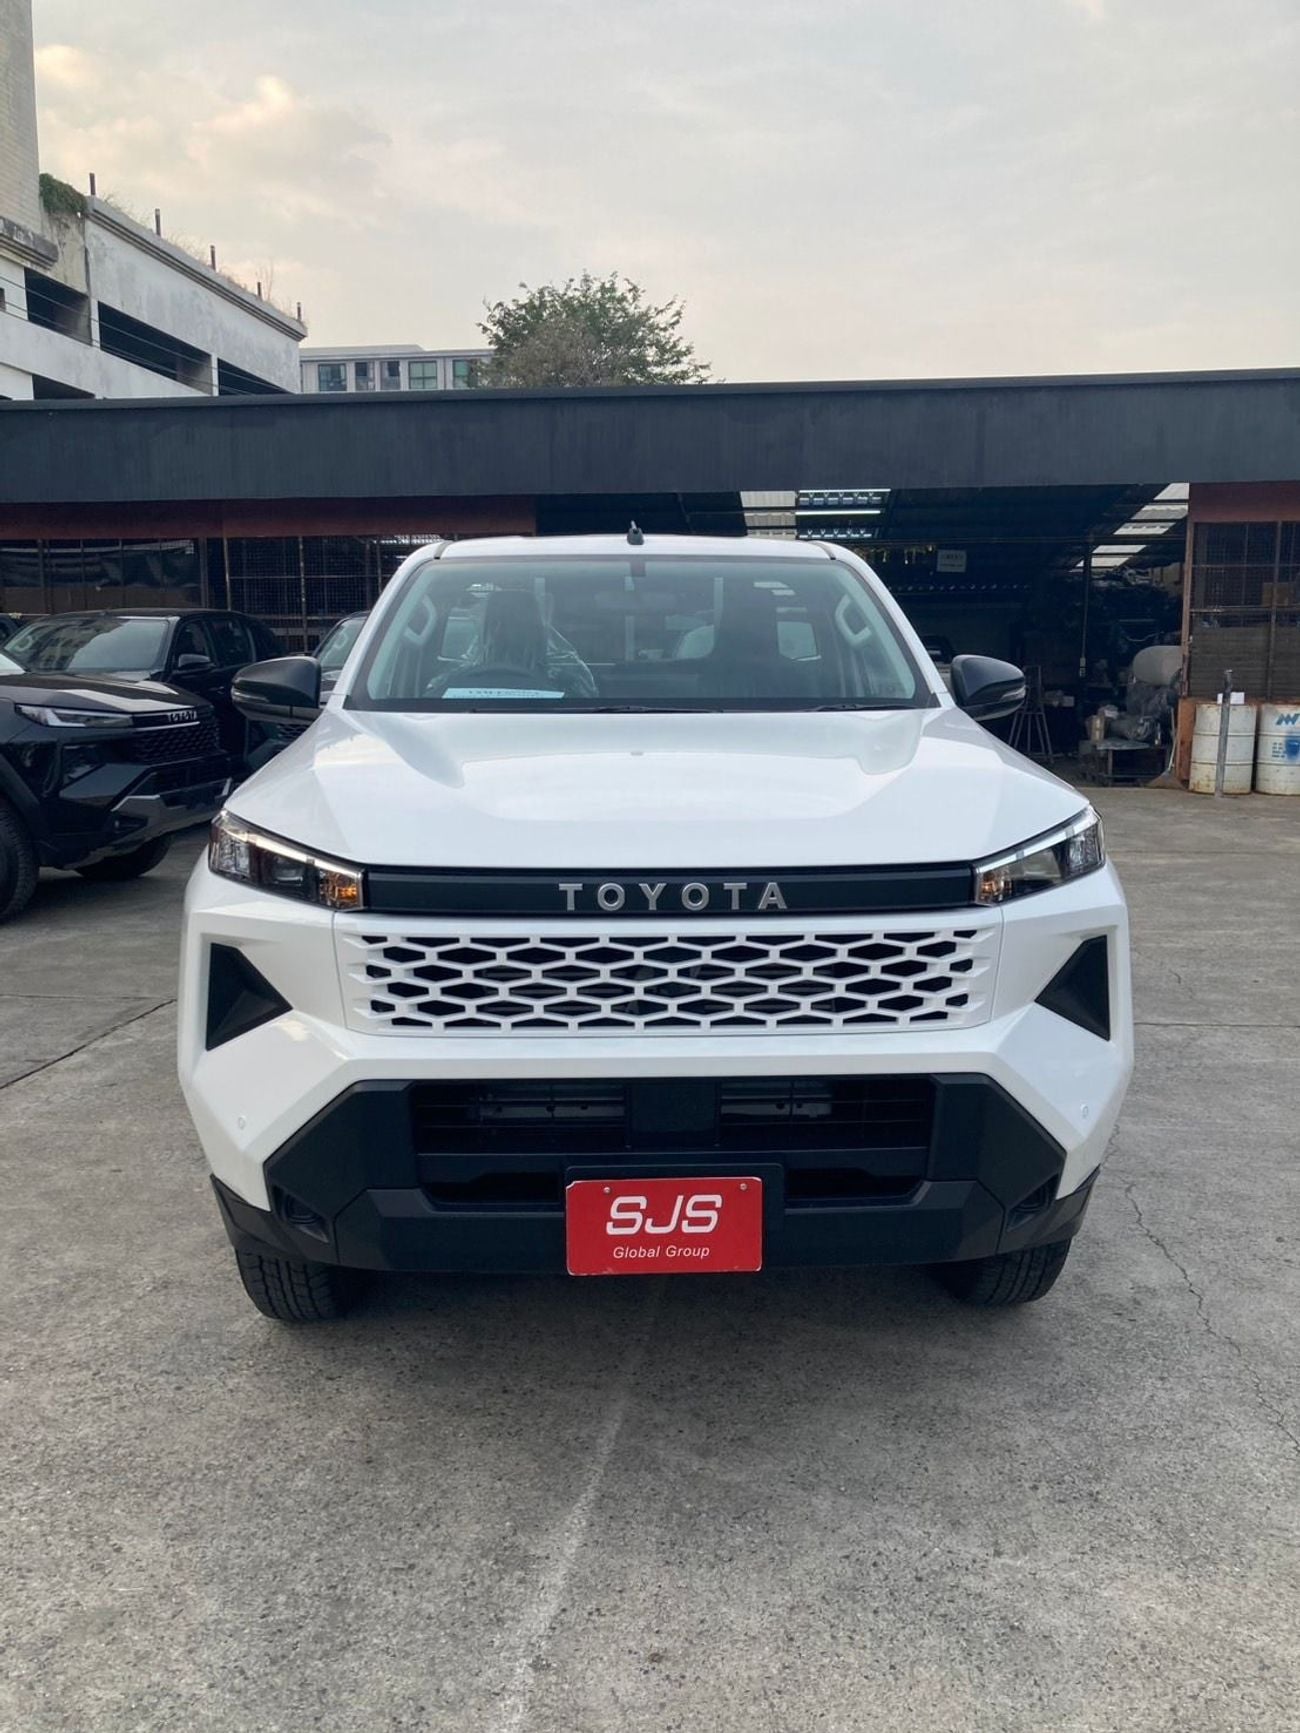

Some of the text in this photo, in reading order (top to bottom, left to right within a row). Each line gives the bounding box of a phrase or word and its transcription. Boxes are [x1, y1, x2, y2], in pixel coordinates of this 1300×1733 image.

[558, 882, 788, 911] TOYOTA
[606, 1194, 723, 1235] SJS
[613, 1244, 710, 1259] Global Group
